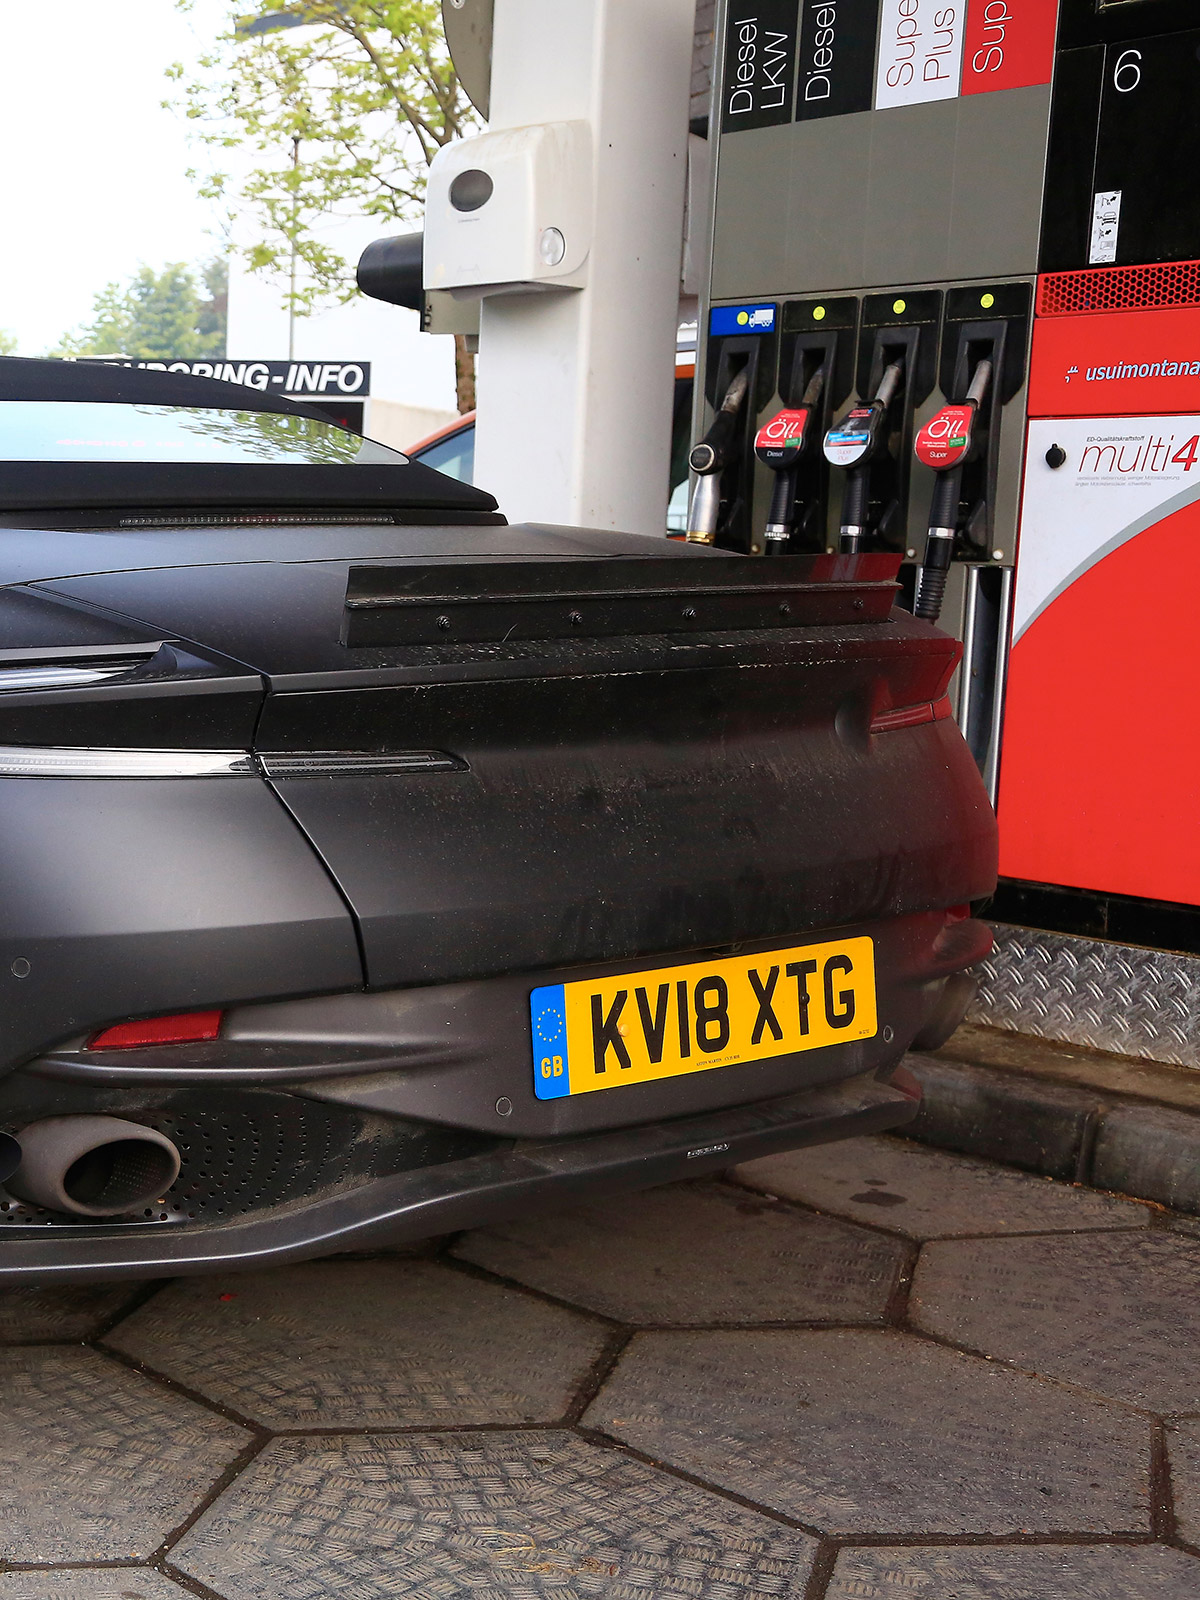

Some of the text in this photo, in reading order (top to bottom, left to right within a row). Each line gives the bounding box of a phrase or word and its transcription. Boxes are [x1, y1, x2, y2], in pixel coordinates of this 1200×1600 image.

[729, 17, 758, 115] Diesel
[760, 31, 789, 109] LKW
[804, 1, 837, 102] Diesel
[923, 8, 956, 82] Plus
[972, 0, 1013, 74] Sup
[1114, 49, 1142, 93] 6
[929, 451, 948, 459] Super
[590, 954, 856, 1074] KV18 XTG
[541, 1055, 563, 1078] GB
